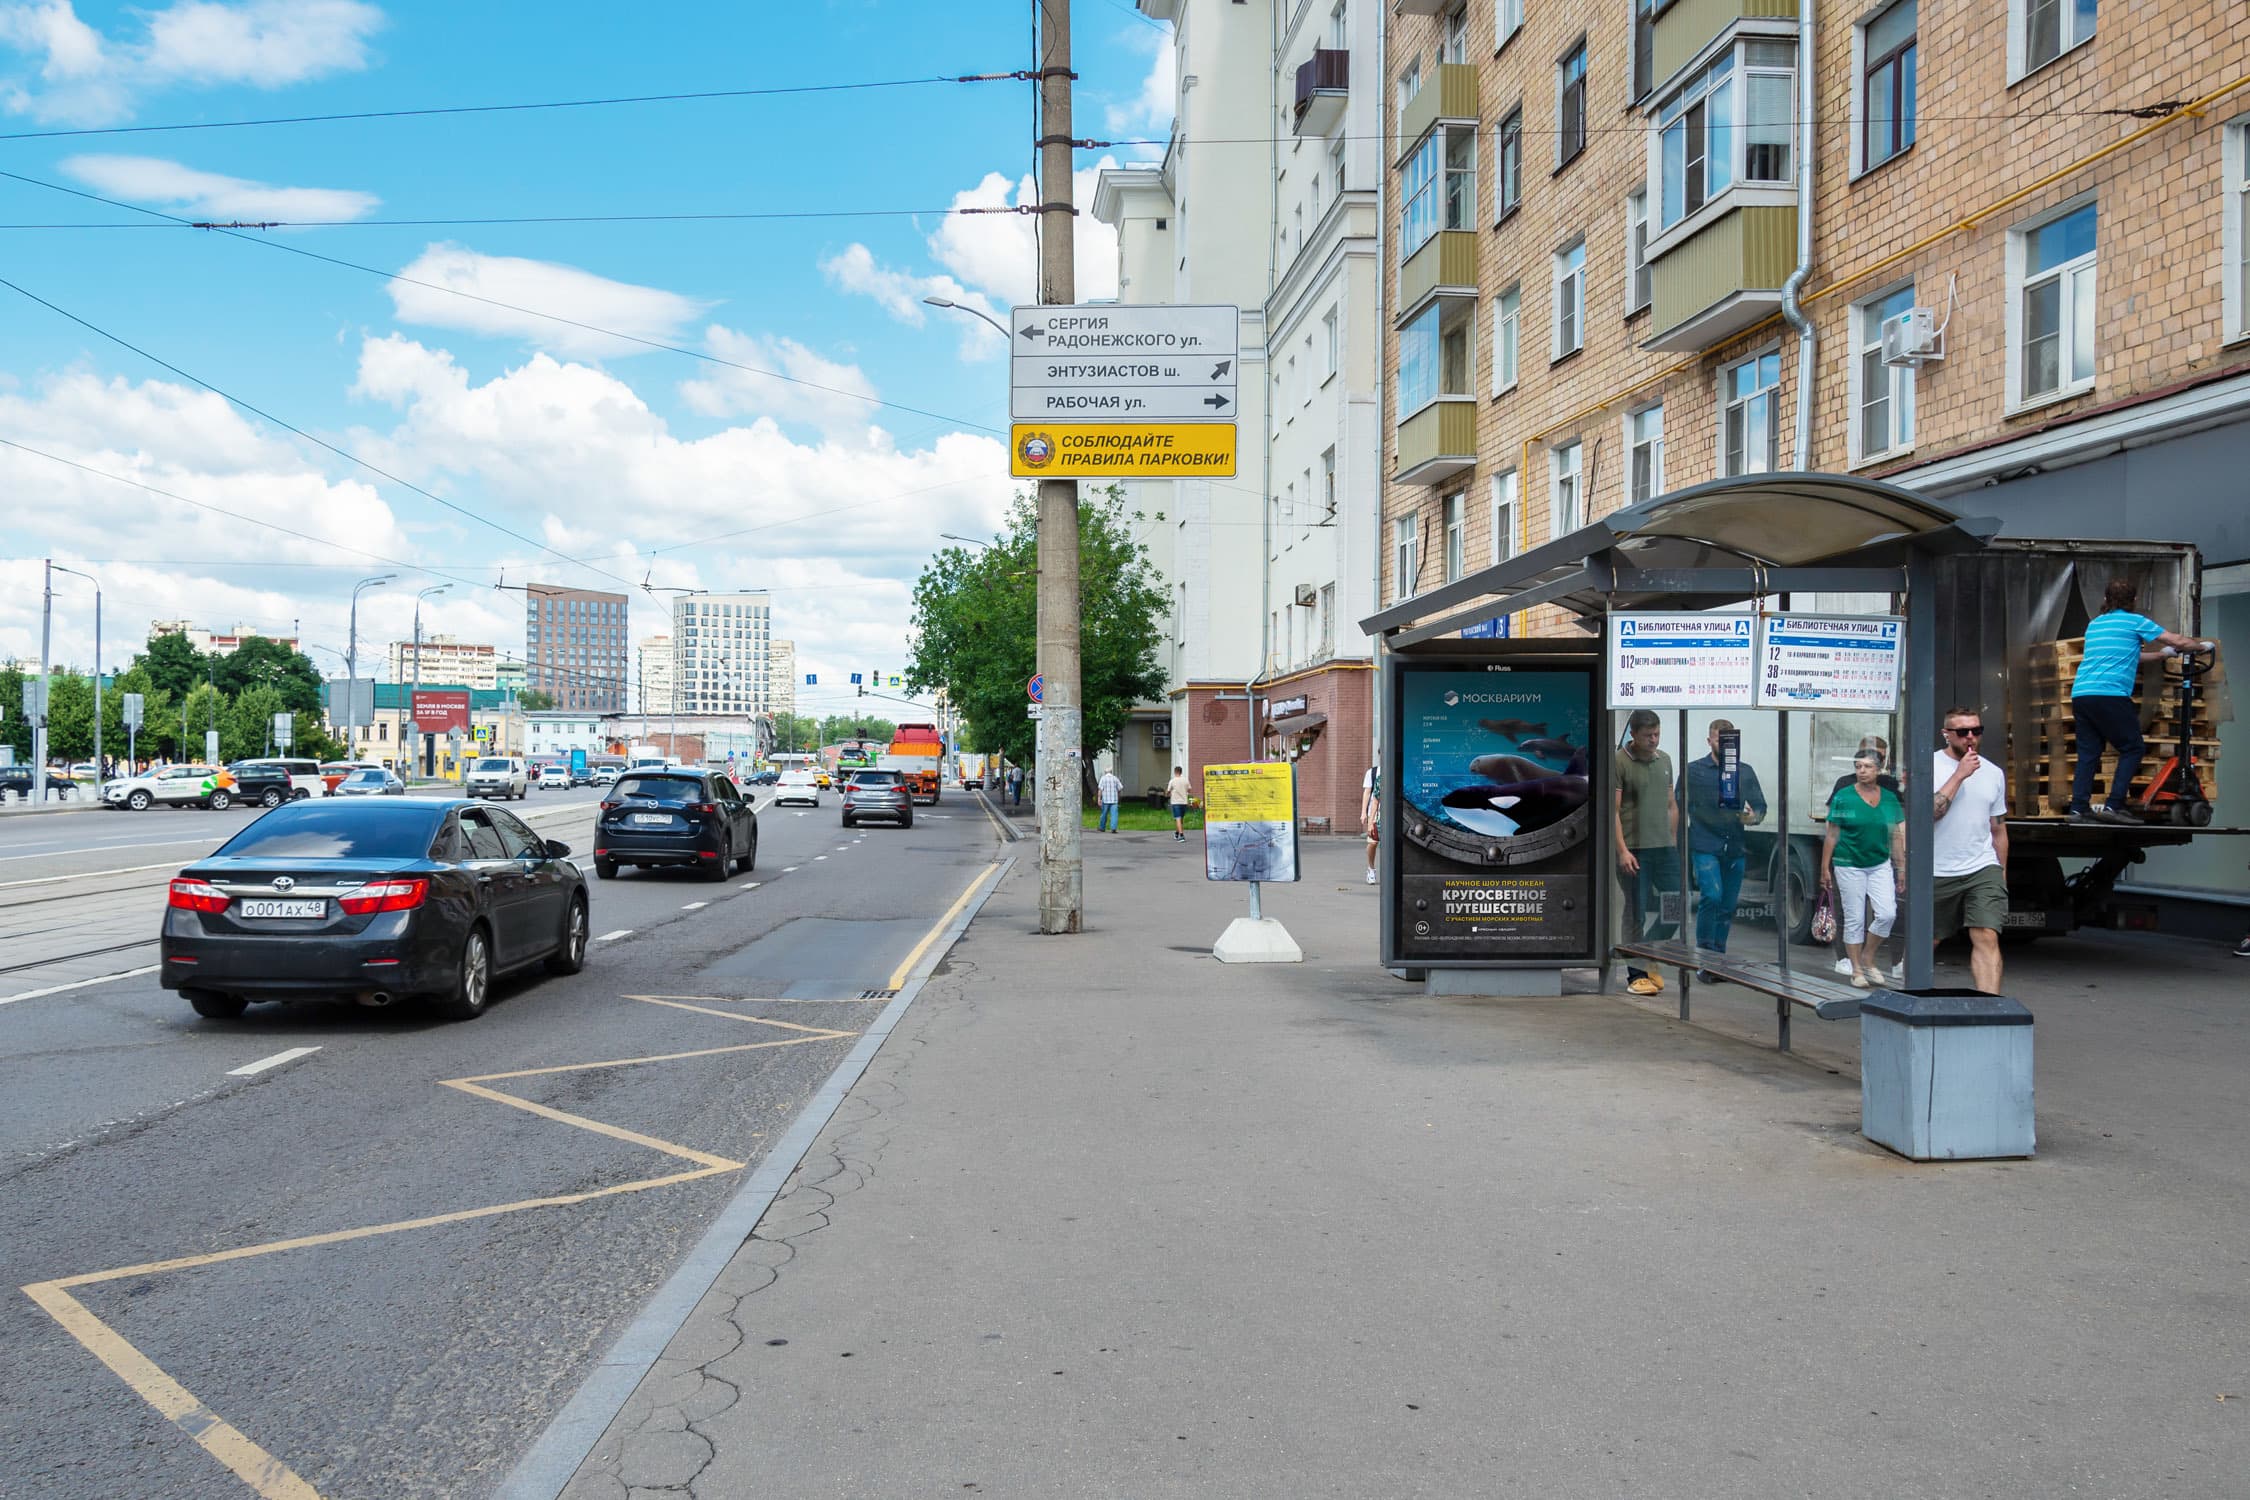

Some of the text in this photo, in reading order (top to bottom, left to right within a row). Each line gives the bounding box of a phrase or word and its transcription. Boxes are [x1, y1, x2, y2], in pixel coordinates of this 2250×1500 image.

[1047, 317, 1109, 330] СЕРГИЯ
[1047, 334, 1202, 349] РАДОНЕЖСКОГО ул.
[1047, 365, 1180, 378] ЭНТУЗИАСТОВ ш.
[1047, 396, 1146, 411] РАБОЧАЯ ул.
[1061, 432, 1174, 450] СОБЛЮДАЙТЕ
[1060, 453, 1230, 466] ПРАВИЛА ПАРКОВКИ!
[1621, 621, 1635, 635] А
[1637, 622, 1702, 632] БИБЛИОТЕЧНАЯ
[1704, 622, 1731, 633] УЛИЦА
[1786, 620, 1849, 632] БИБЛИОТЕЧНАЯ
[1851, 623, 1879, 634] УЛИЦА
[1769, 646, 1781, 661] 12
[1494, 664, 1512, 672] Russ
[1620, 654, 1635, 669] 012
[1767, 664, 1779, 679] 38
[1620, 682, 1635, 697] 365
[1641, 685, 1656, 694] МЕТРО
[1764, 683, 1778, 697] 46
[1462, 693, 1542, 704] МОСКВАРИУМ
[1442, 889, 1548, 901] КРУГОСВЕТНОЕ
[306, 902, 321, 913] 48
[1445, 903, 1544, 914] ПУТЕШЕСТВИЕ
[1417, 923, 1428, 932] 0+
